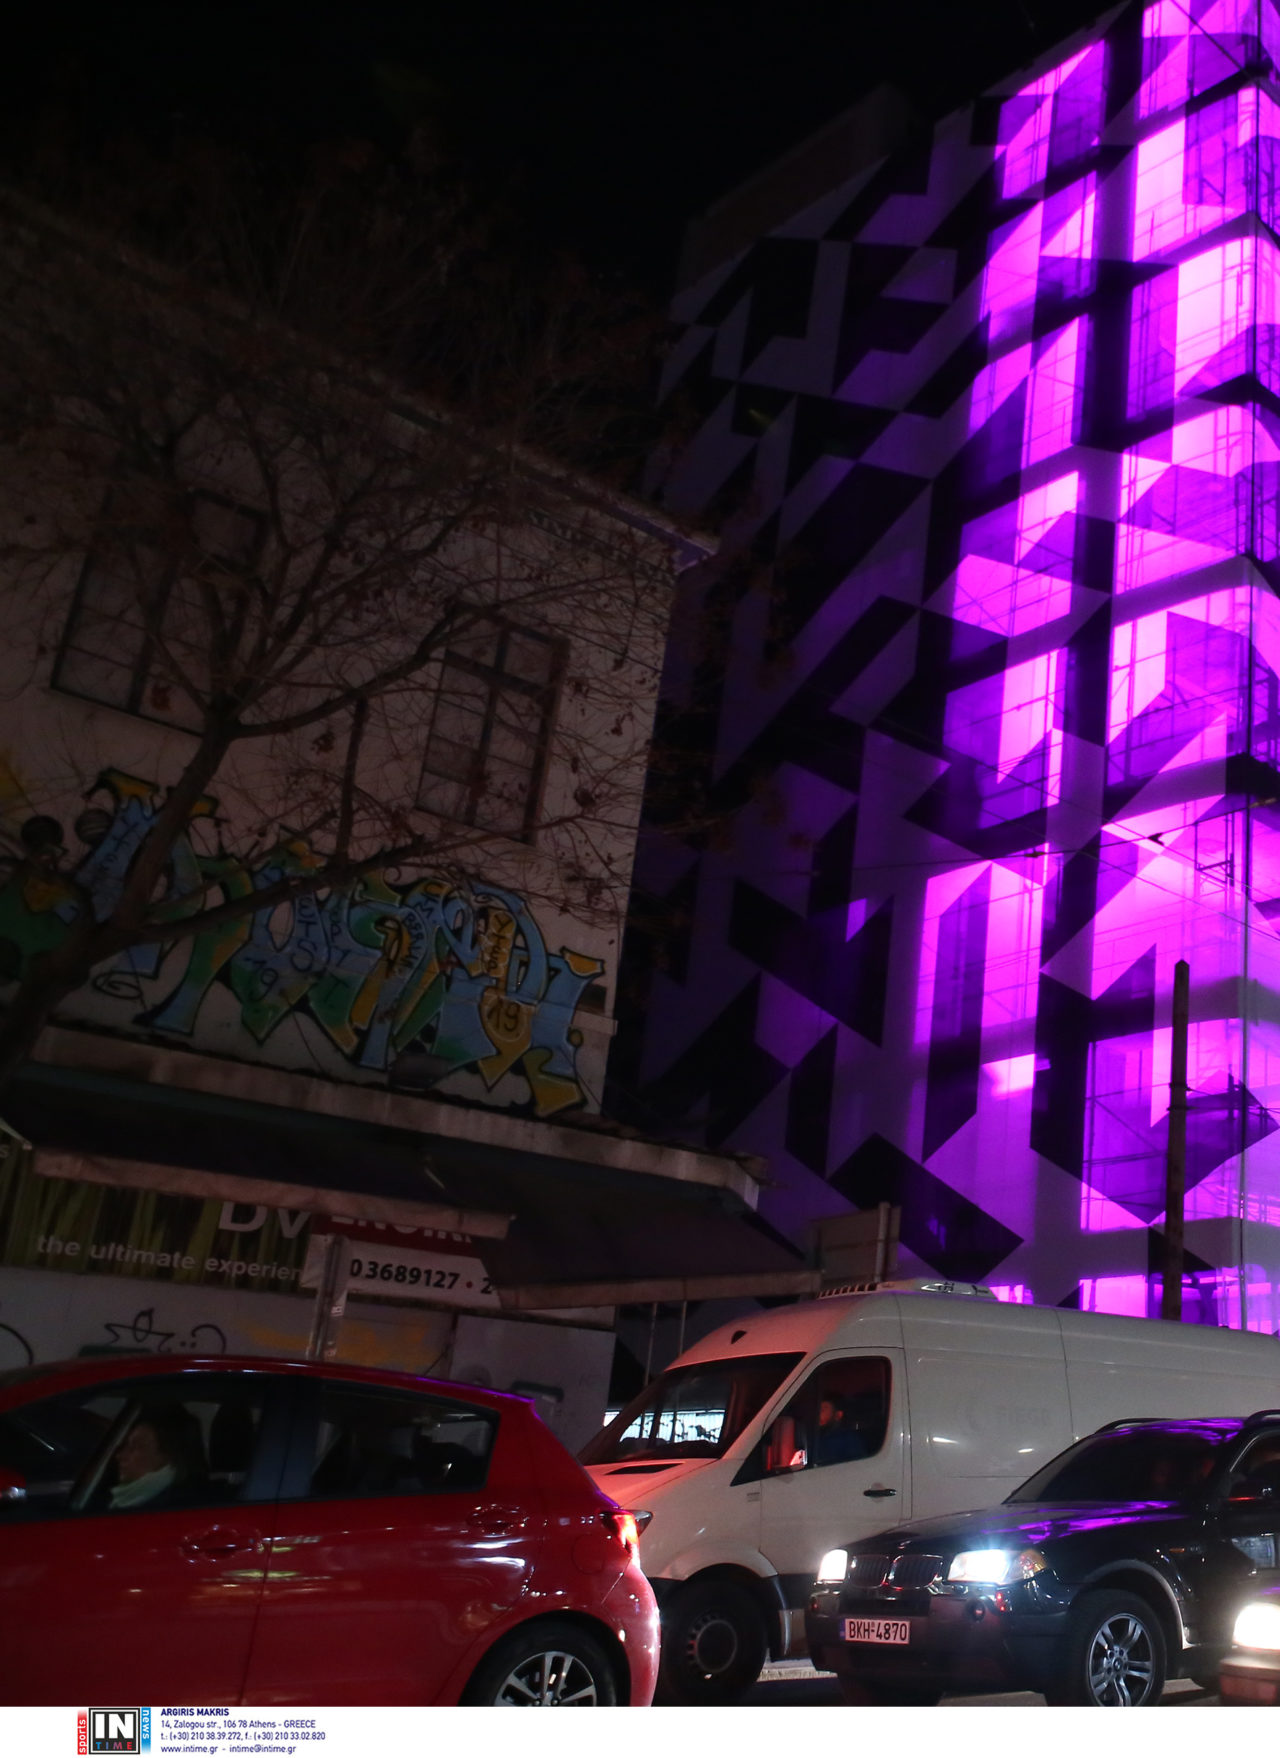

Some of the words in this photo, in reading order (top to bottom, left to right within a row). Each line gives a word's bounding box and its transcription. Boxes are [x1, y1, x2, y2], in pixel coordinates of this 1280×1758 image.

[487, 1004, 520, 1033] 19
[37, 1235, 81, 1257] the
[90, 1241, 196, 1270] ultimate
[848, 1621, 908, 1641] BKH-4870
